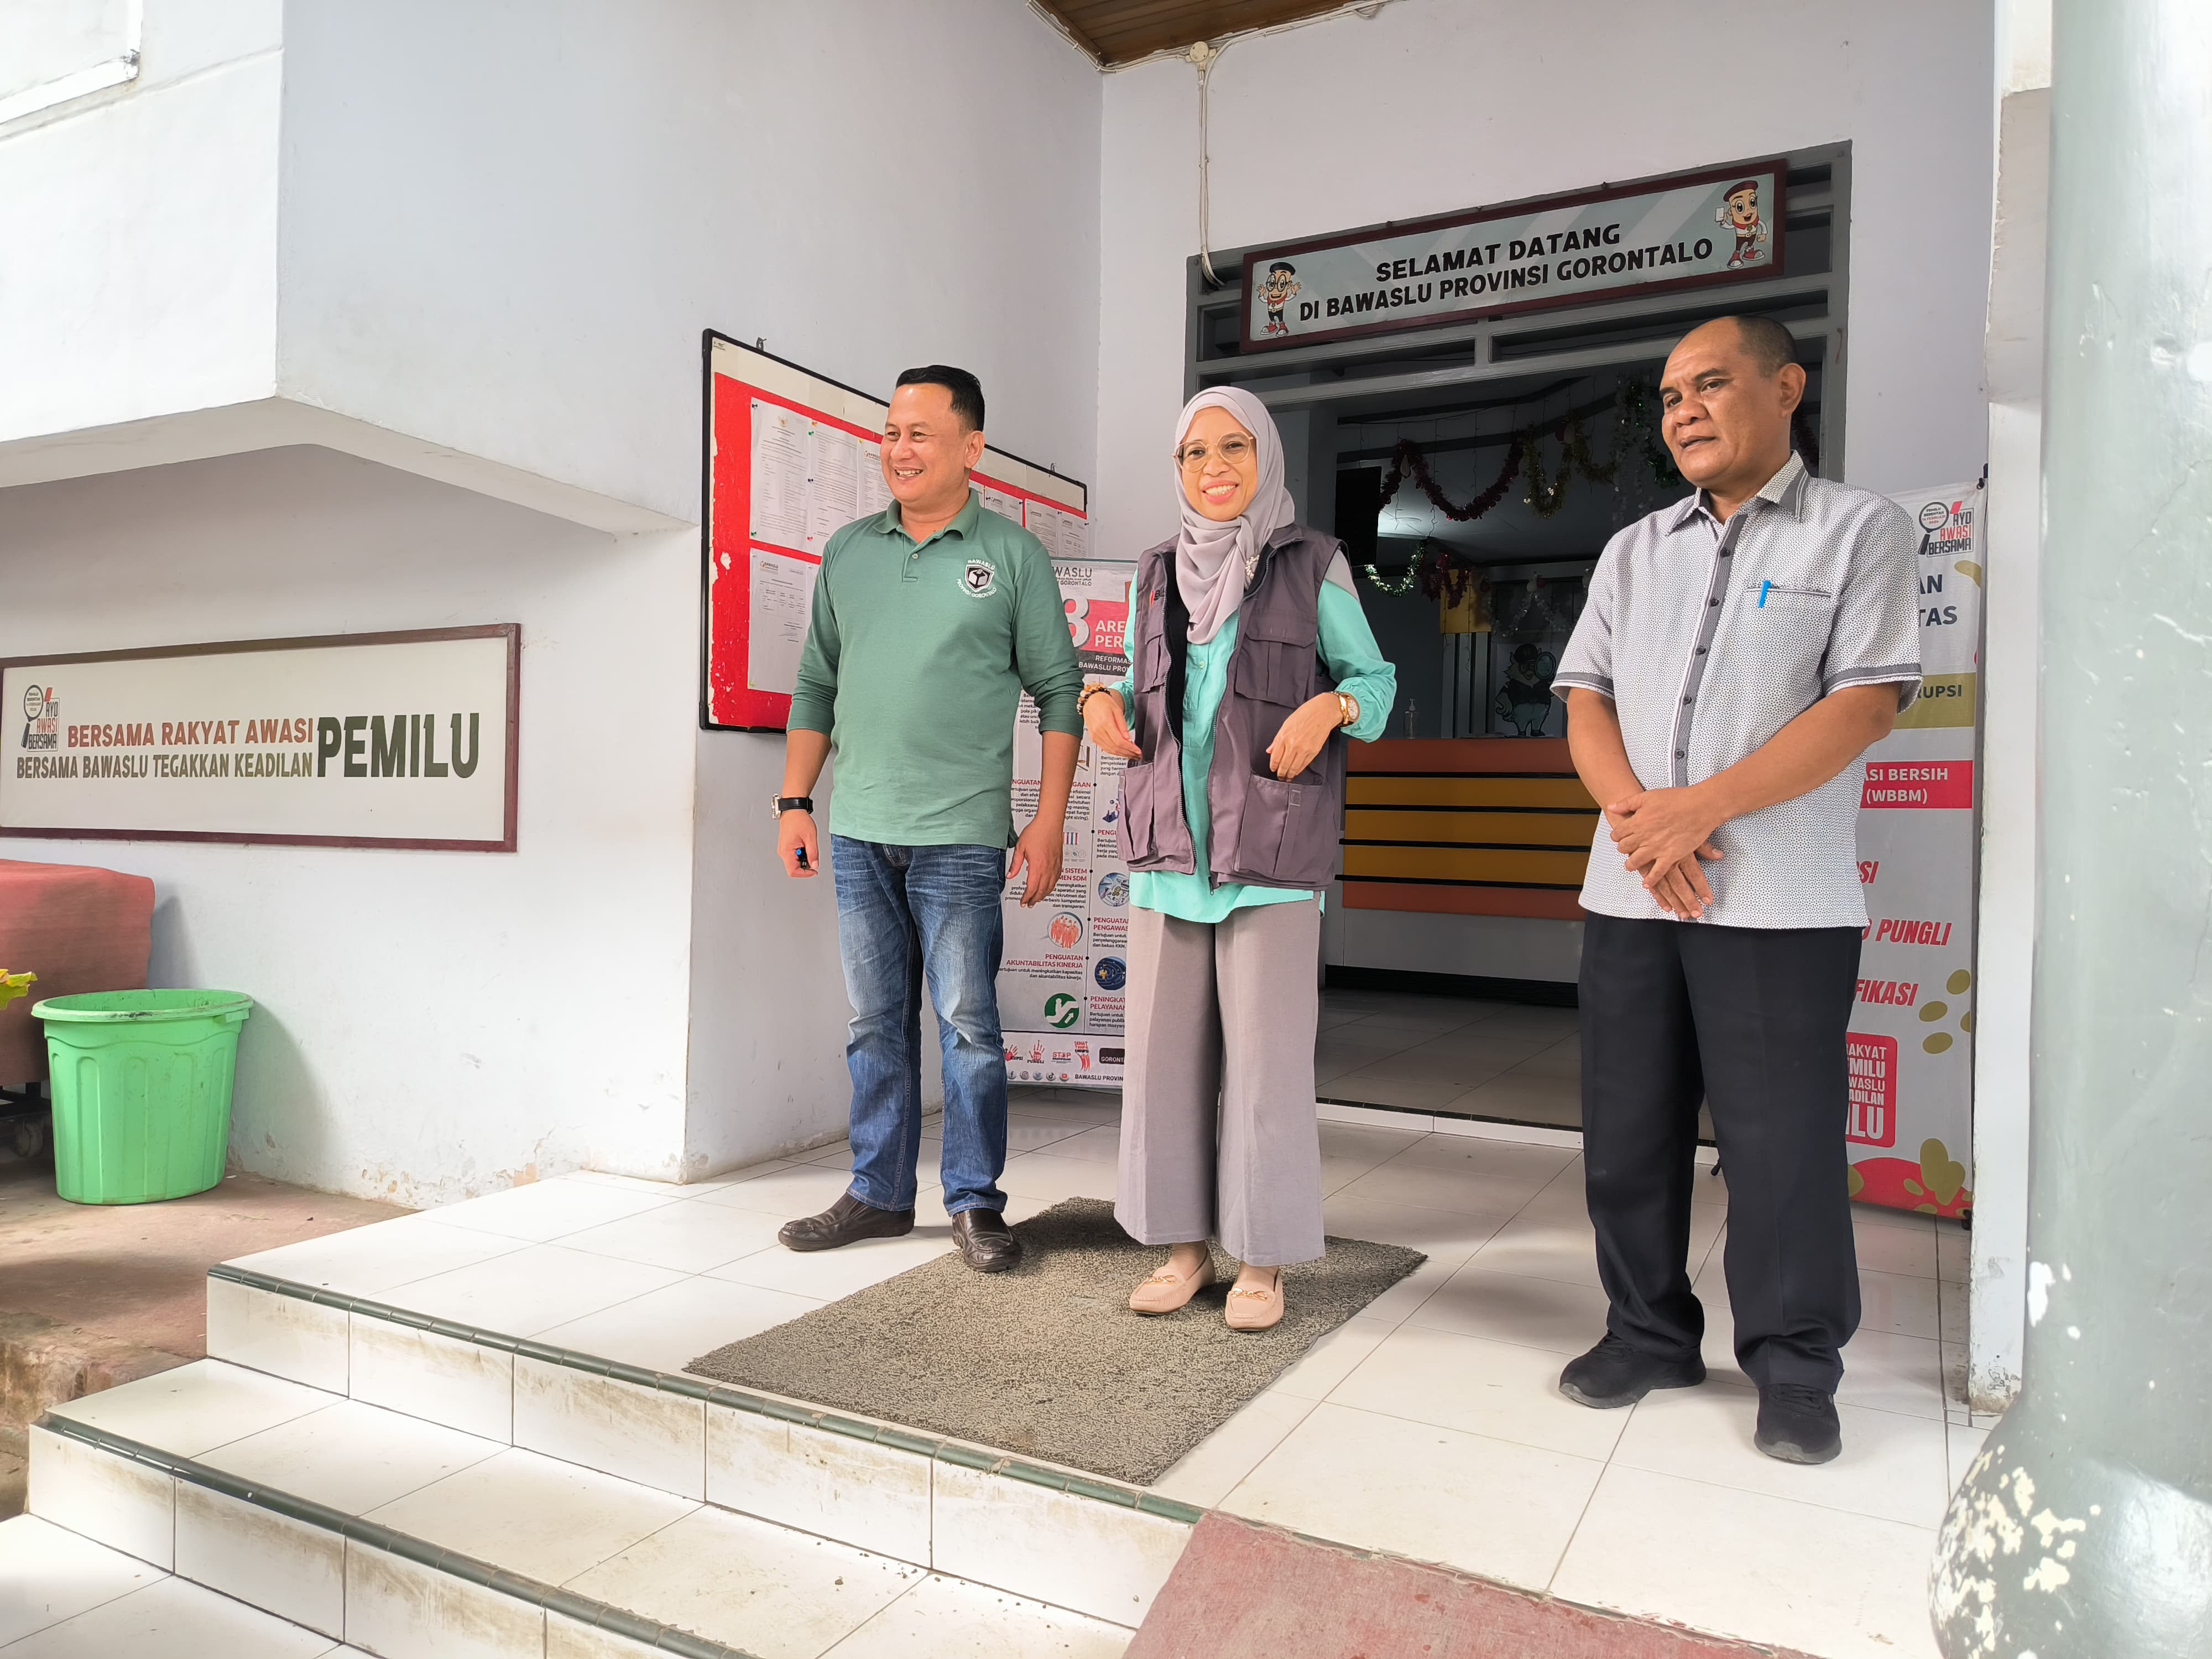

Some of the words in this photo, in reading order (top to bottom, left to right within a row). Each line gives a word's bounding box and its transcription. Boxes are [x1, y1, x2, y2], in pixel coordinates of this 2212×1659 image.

[1376, 243, 1501, 282] SELAMAT
[1509, 223, 1620, 261] DATANG
[1300, 300, 1319, 321] DI
[1327, 283, 1432, 317] BAWASLU
[1439, 264, 1548, 299] PROVINSI
[1557, 238, 1713, 281] GORONTALO
[1953, 512, 1971, 526] AYO
[1940, 525, 1971, 540] AWASI
[1928, 538, 1971, 555] BERSAMA
[1078, 661, 1111, 671] BAWASLU
[46, 701, 58, 717] AYO
[36, 718, 58, 733] AWASI
[67, 722, 154, 748] BERSAMA
[161, 720, 240, 745] RAKYAT
[245, 718, 313, 743] AWASI
[28, 733, 57, 749] BERSAMA
[317, 712, 479, 778] PEMILU
[17, 756, 79, 779] BERSAMA
[82, 754, 148, 778] BAWASLU
[153, 753, 229, 778] TEGAKKAN
[234, 752, 312, 777] KEADILAN
[1888, 768, 1948, 781] BERSIH
[1866, 788, 1928, 805] (WBBM)
[1875, 919, 1952, 946] PUNGLI
